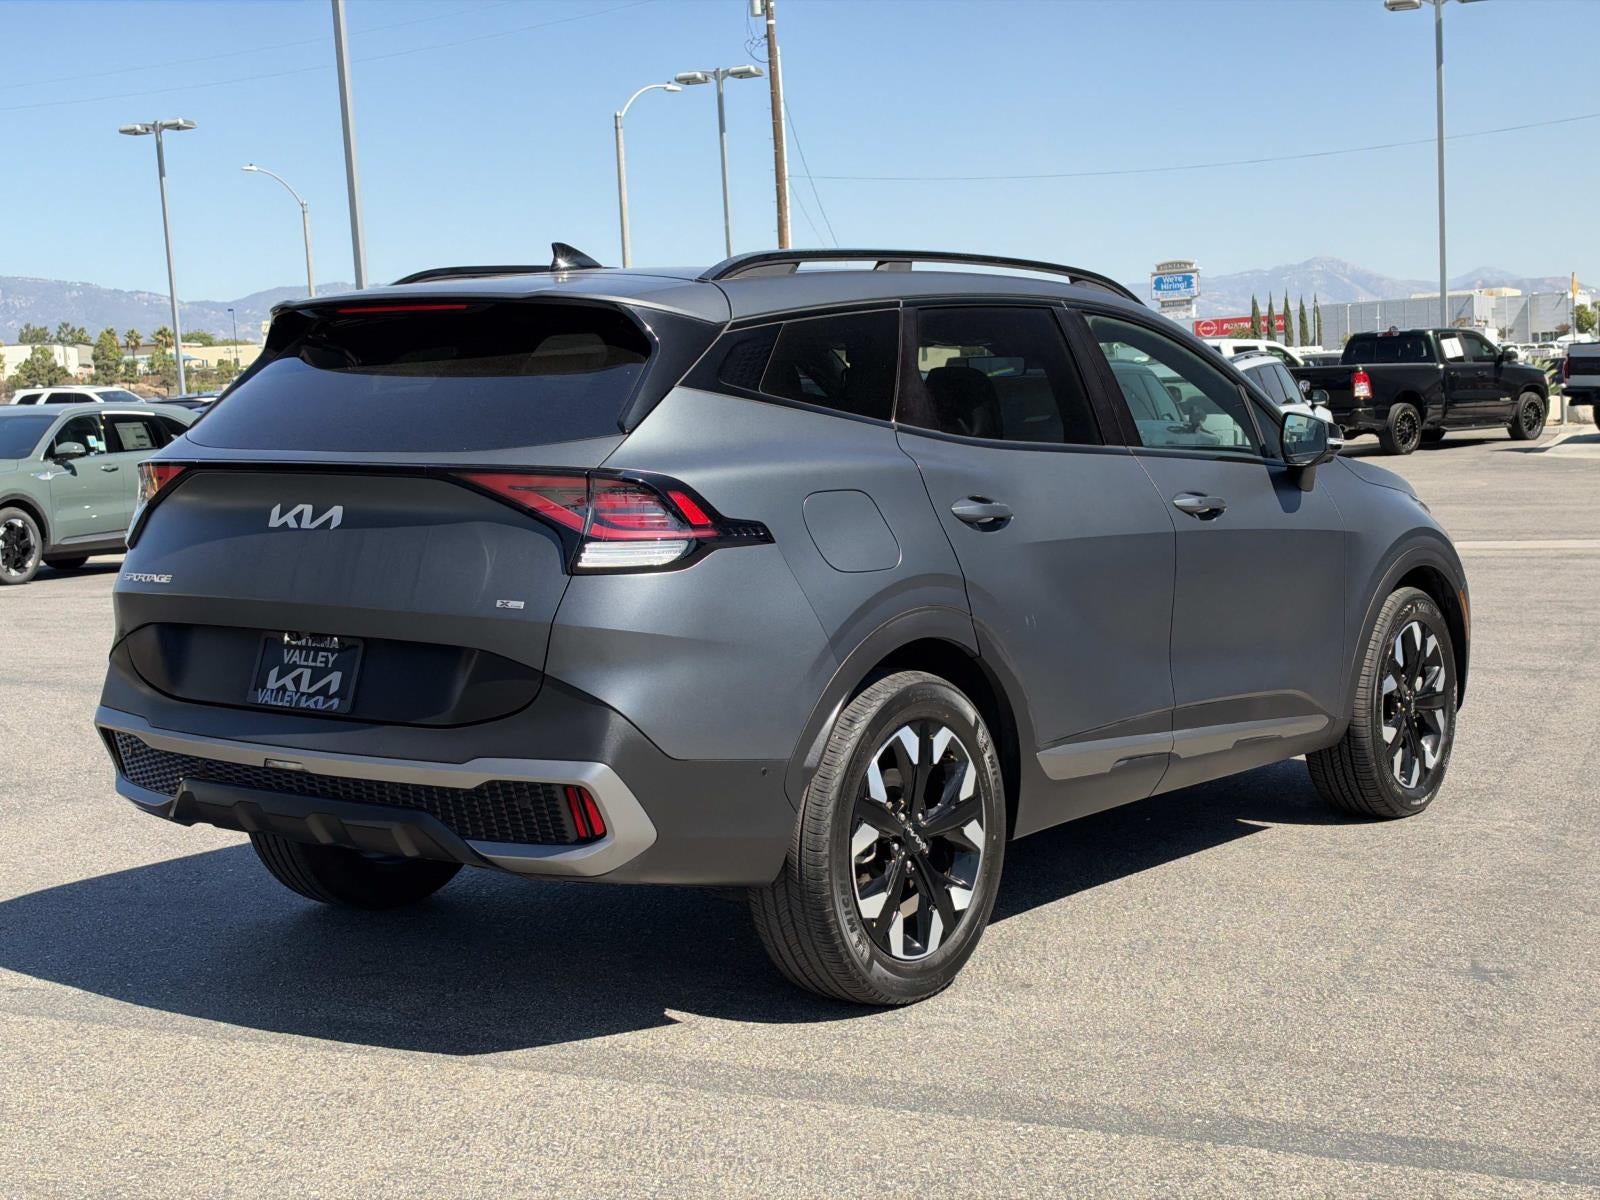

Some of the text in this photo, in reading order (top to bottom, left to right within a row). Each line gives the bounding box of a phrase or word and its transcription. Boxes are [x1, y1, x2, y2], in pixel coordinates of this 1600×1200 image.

[1161, 281, 1188, 290] Hiring!
[268, 503, 343, 530] KIA
[122, 572, 173, 583] SPORTAGE
[283, 648, 338, 668] VALLEY
[266, 665, 342, 696] KIA
[257, 687, 300, 707] VALLEY
